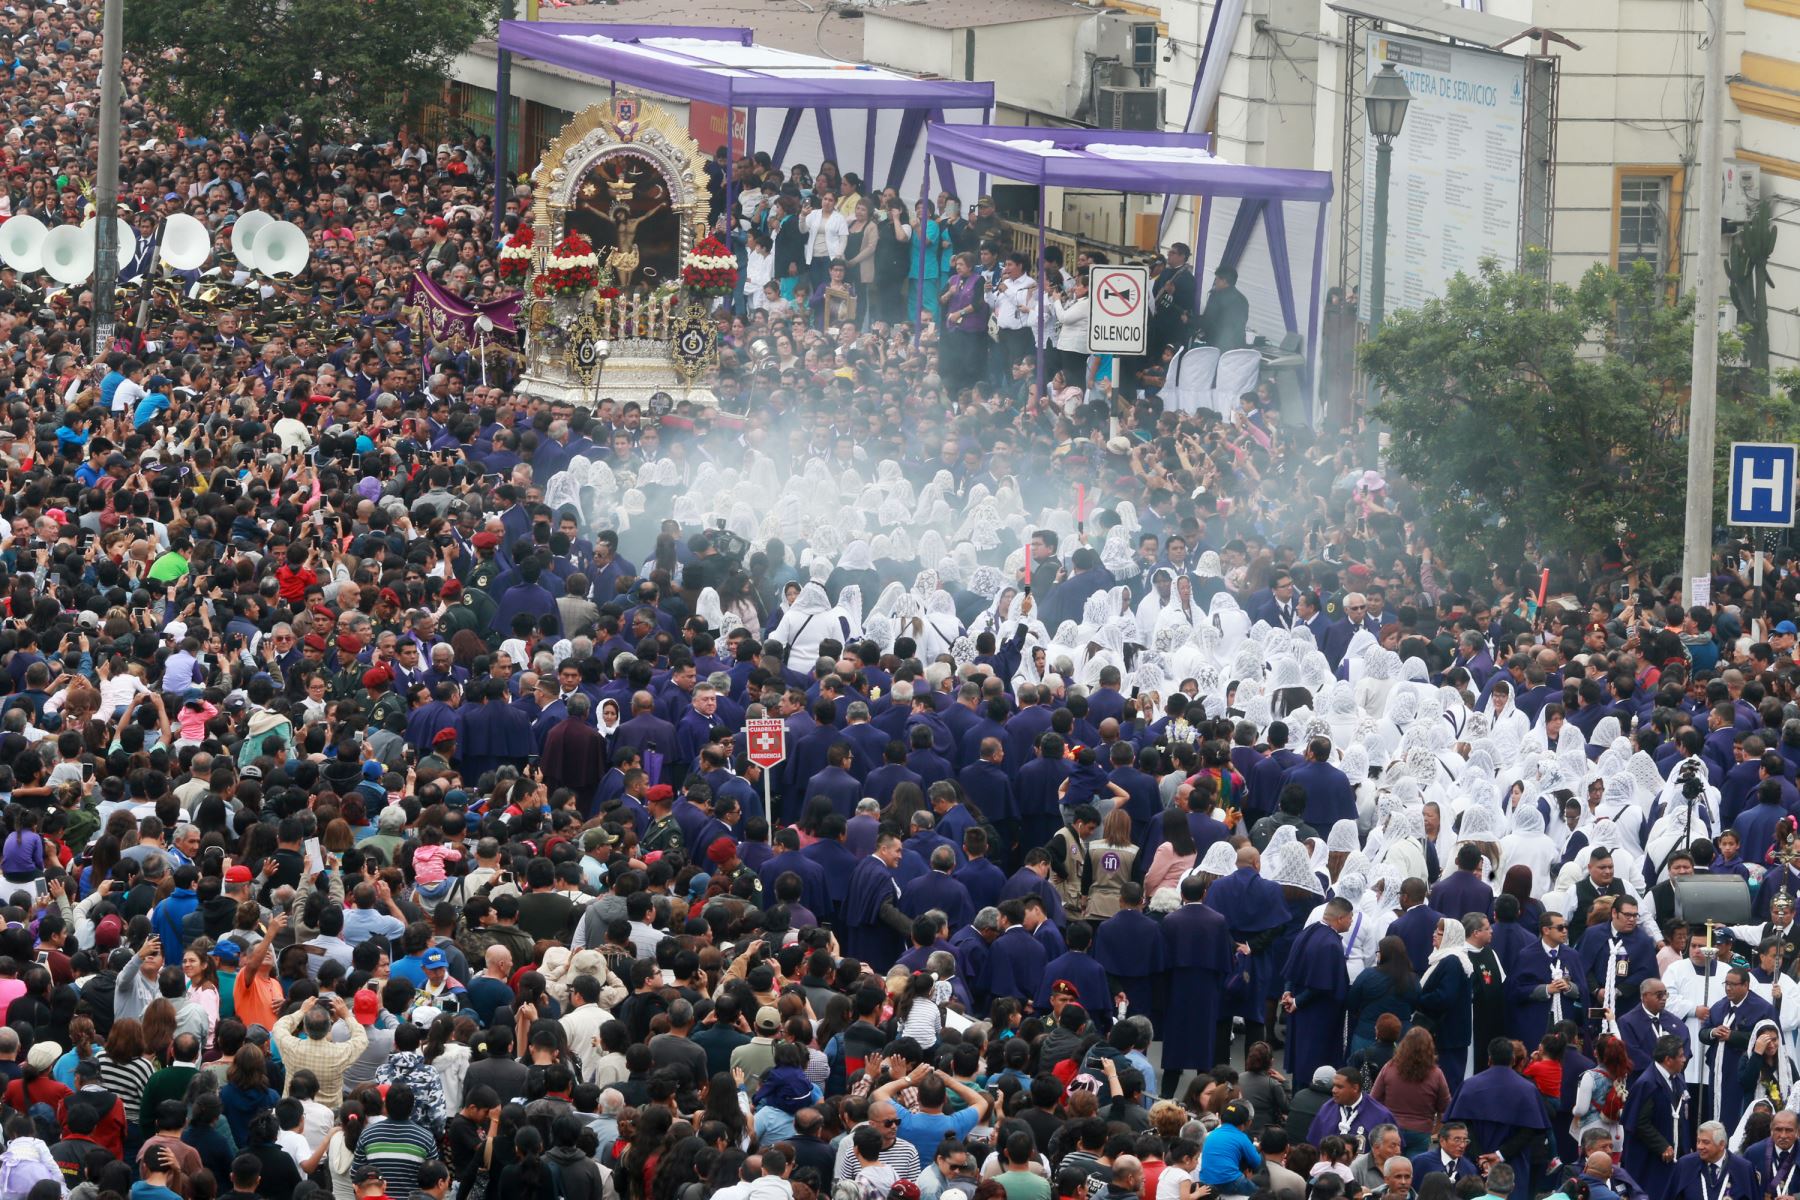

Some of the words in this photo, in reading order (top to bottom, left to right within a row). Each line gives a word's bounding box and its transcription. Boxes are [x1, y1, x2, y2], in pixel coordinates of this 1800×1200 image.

[1439, 77, 1451, 98] DE
[1453, 80, 1497, 107] SERVICIOS
[711, 111, 746, 140] multRed
[1093, 324, 1141, 342] SILENCIO
[1740, 457, 1785, 512] H
